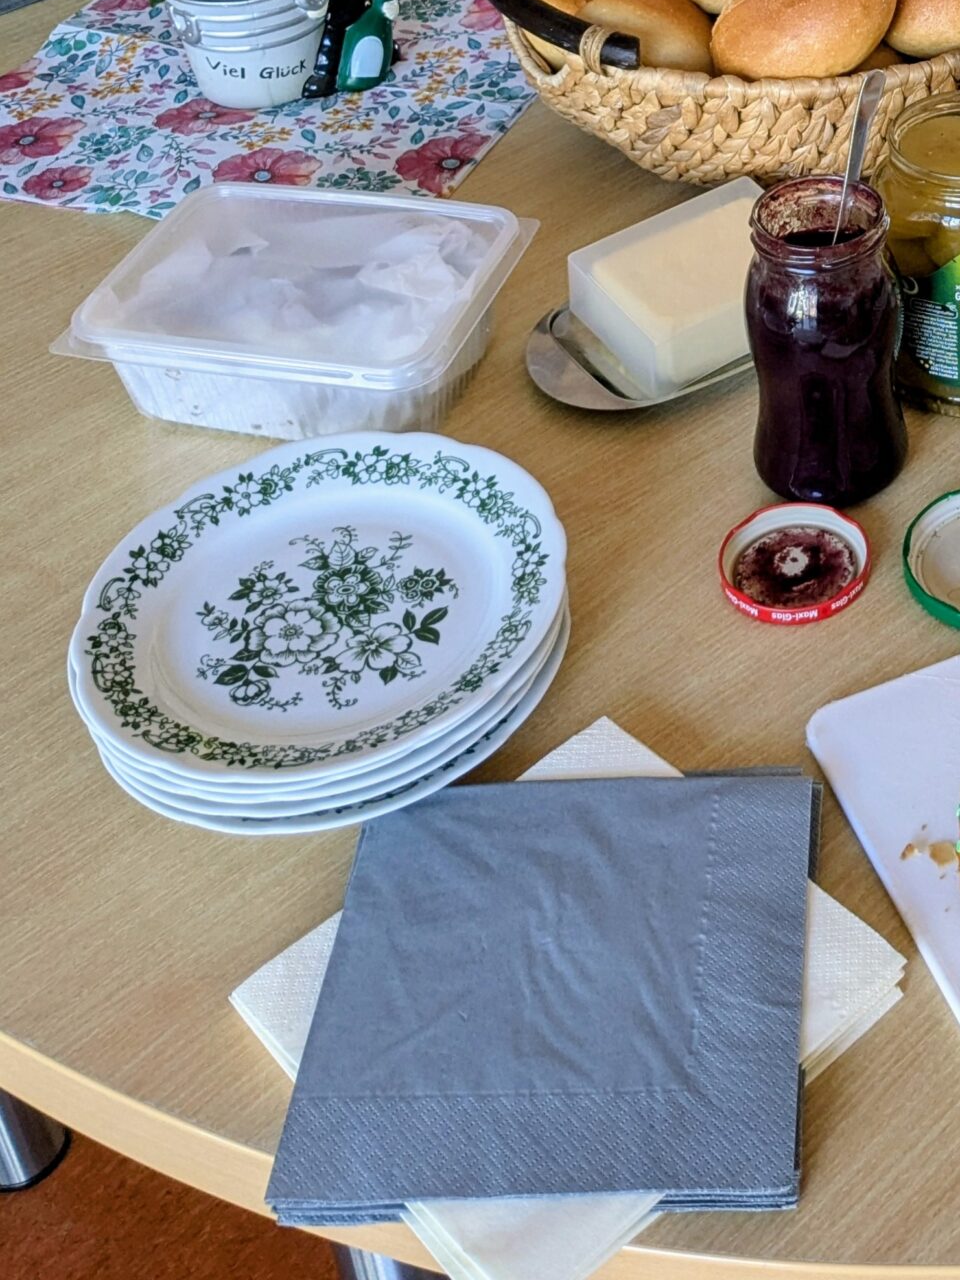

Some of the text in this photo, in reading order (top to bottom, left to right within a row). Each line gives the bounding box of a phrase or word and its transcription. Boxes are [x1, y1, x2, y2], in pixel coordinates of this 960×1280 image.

[205, 56, 306, 79] Viel Glück
[771, 609, 818, 622] Maxi-Glas
